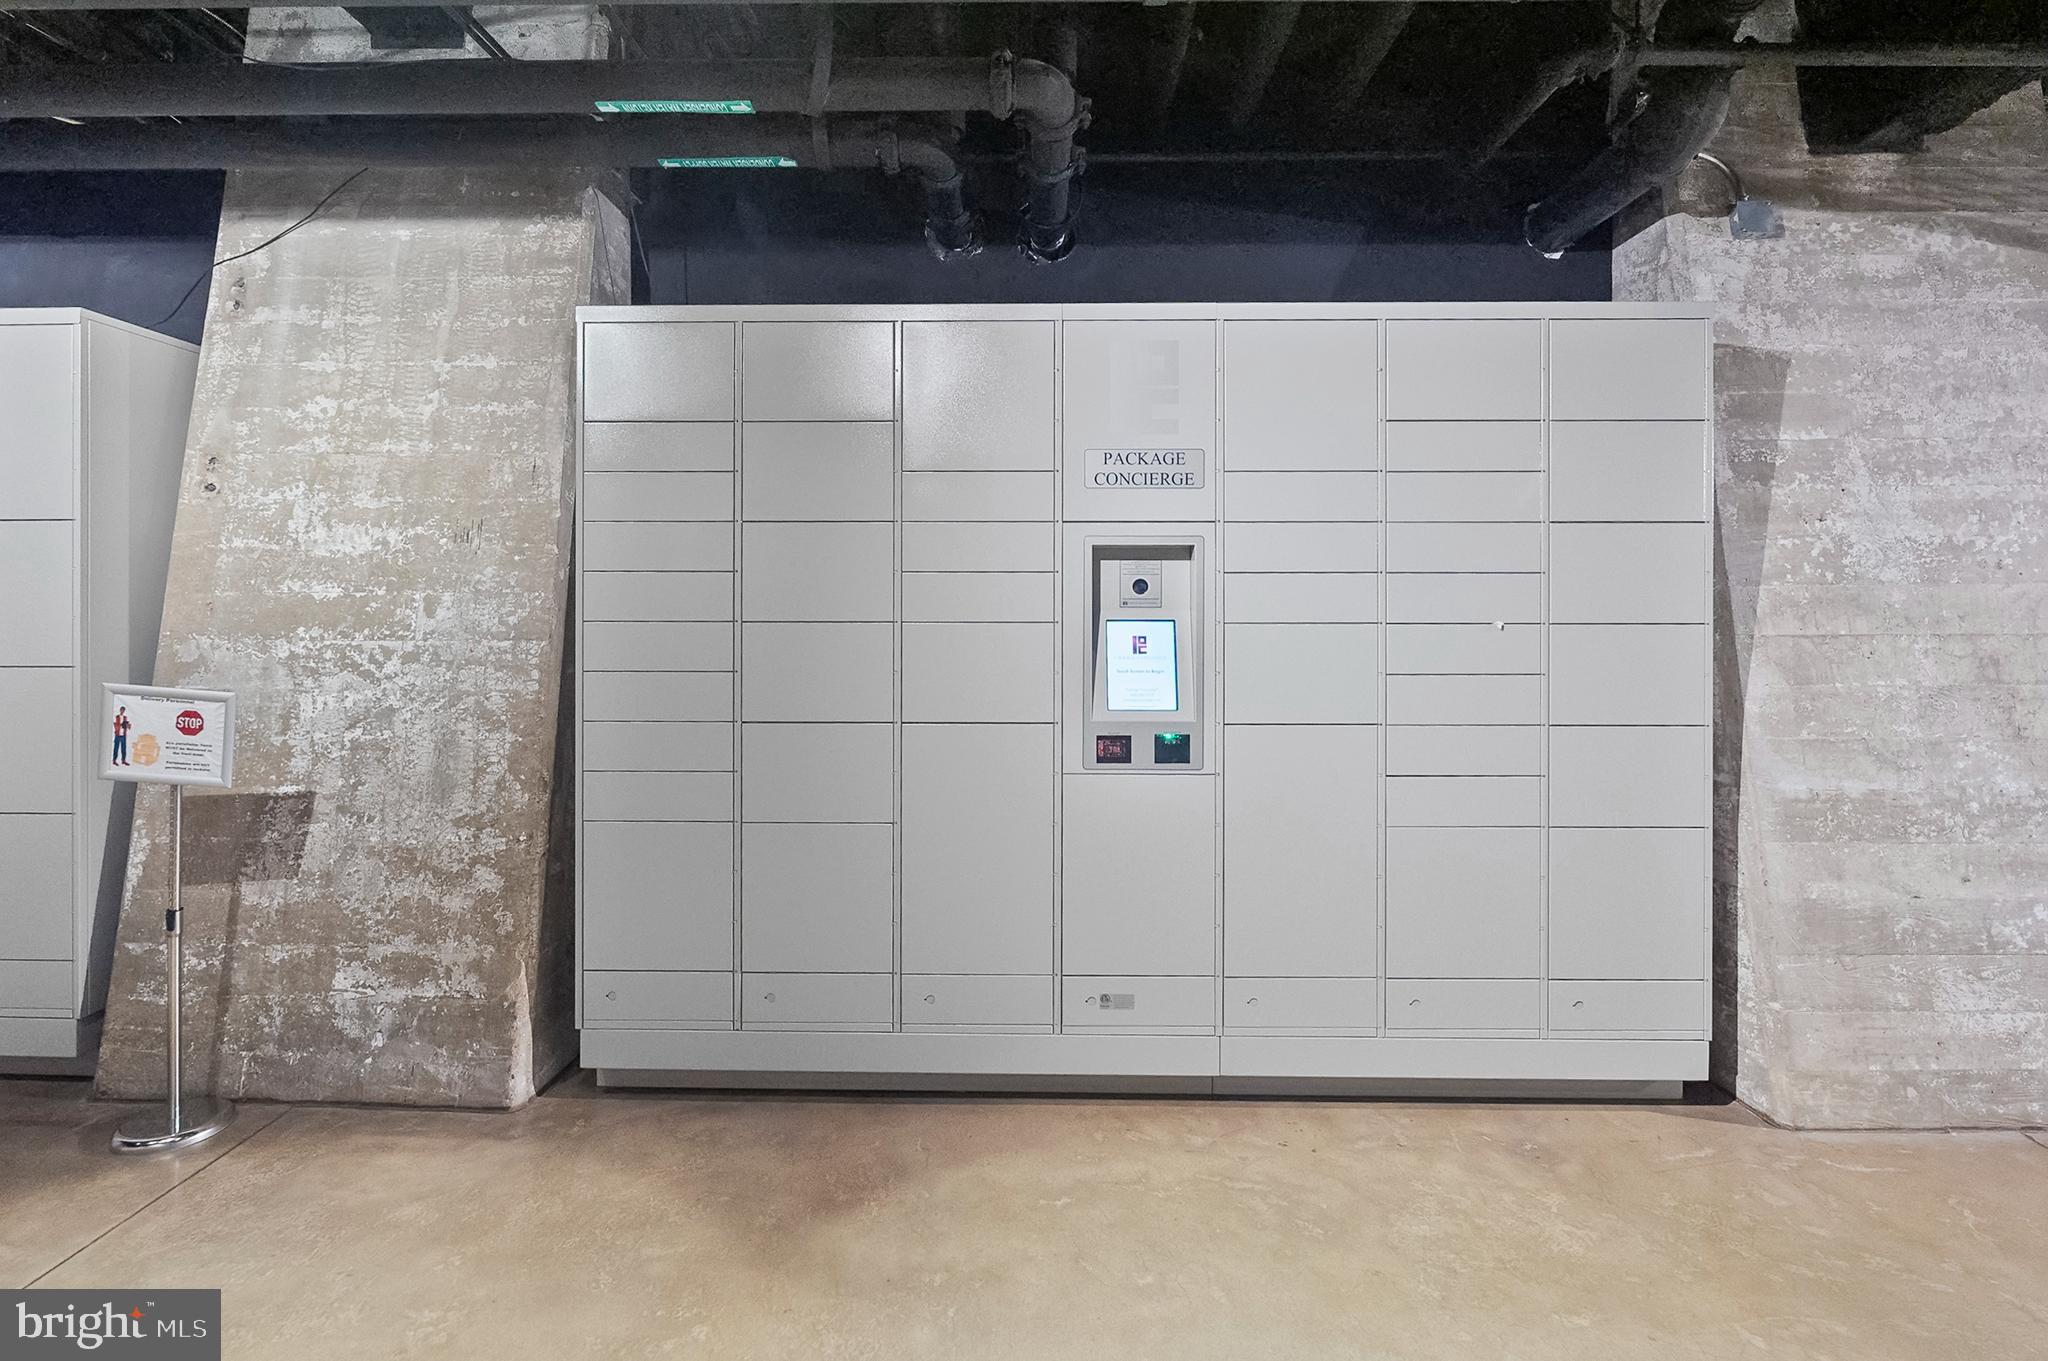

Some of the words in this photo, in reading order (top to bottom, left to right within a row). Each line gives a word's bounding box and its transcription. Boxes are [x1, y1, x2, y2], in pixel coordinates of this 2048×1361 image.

[1103, 451, 1186, 466] PACKAGE
[1094, 472, 1195, 486] CONCIERGE
[177, 717, 203, 729] STOP
